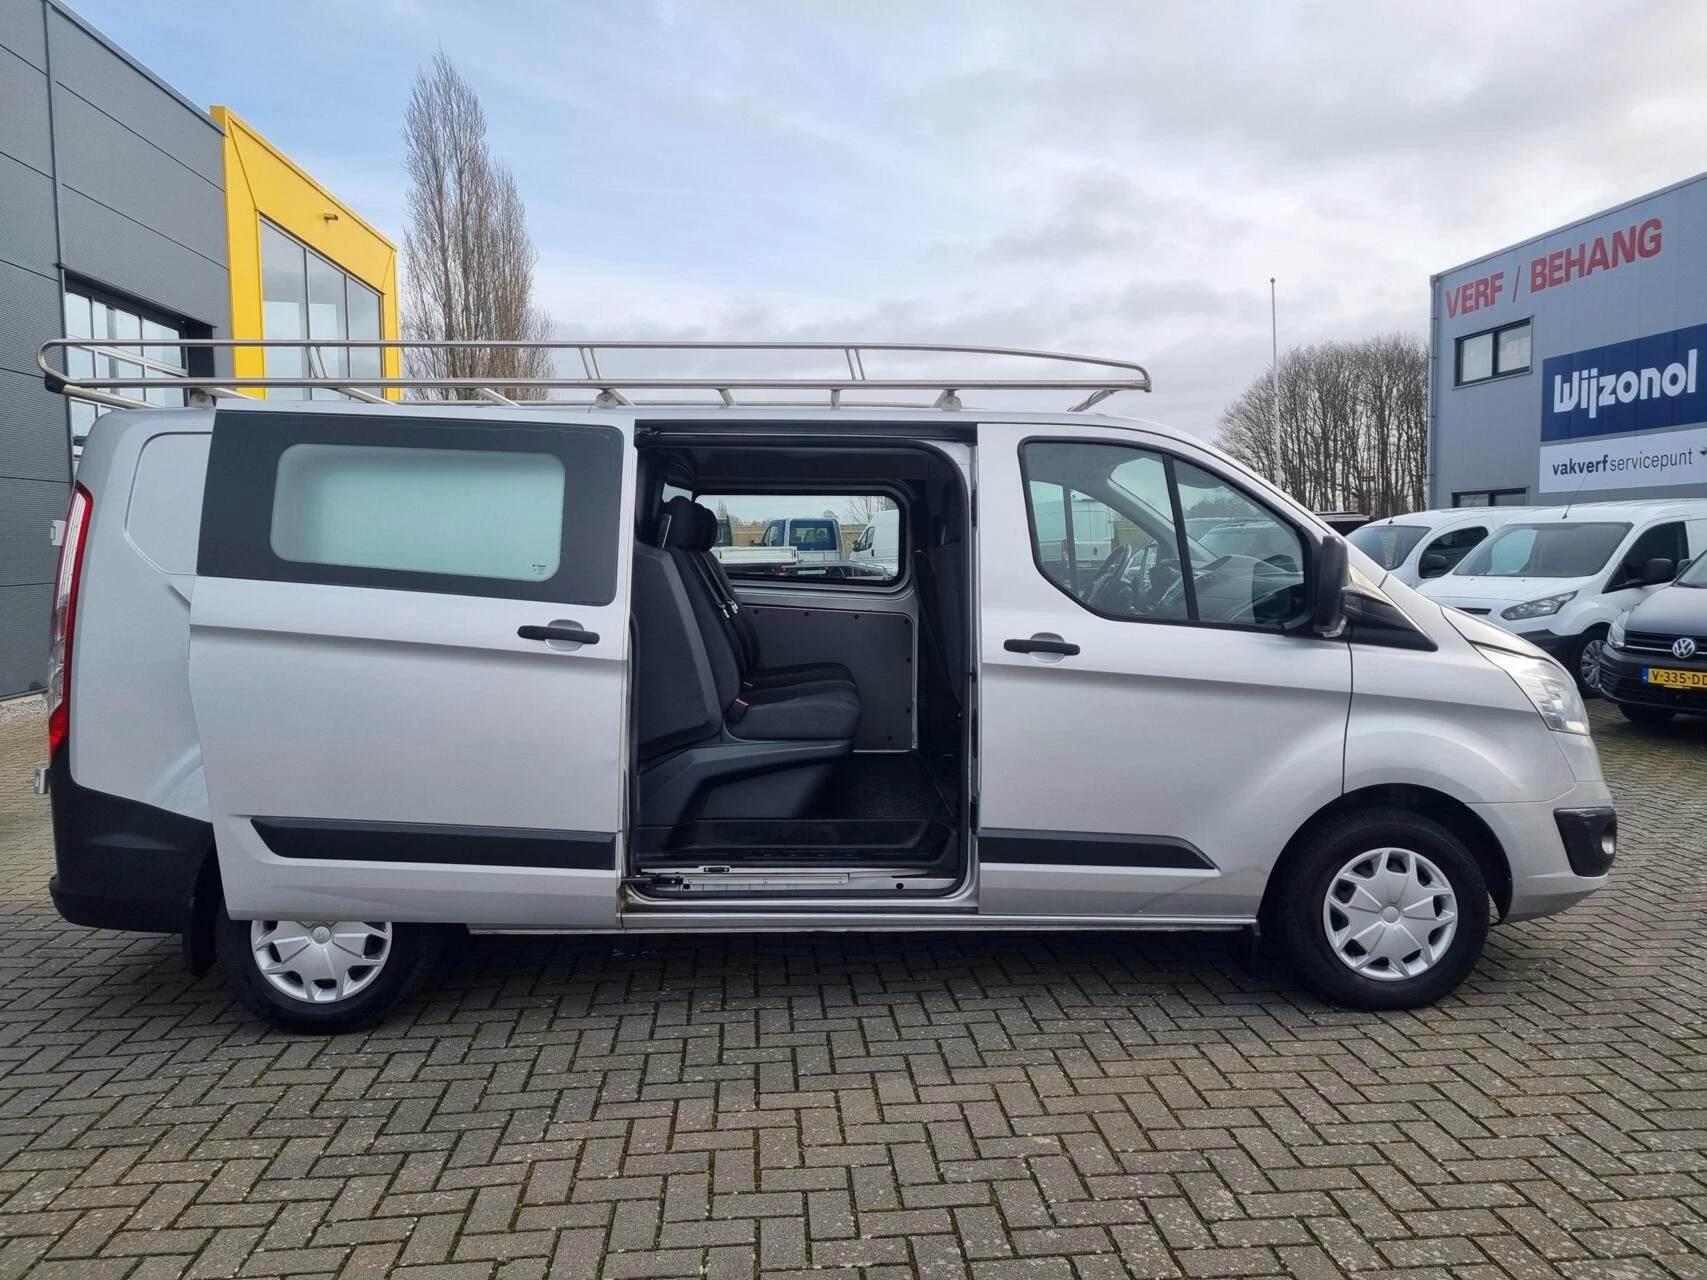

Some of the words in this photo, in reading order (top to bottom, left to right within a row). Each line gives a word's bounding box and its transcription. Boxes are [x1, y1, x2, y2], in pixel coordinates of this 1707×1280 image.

[1444, 271, 1504, 319] VERF
[1530, 218, 1662, 293] BEHANG
[1553, 348, 1698, 419] Wijzonol
